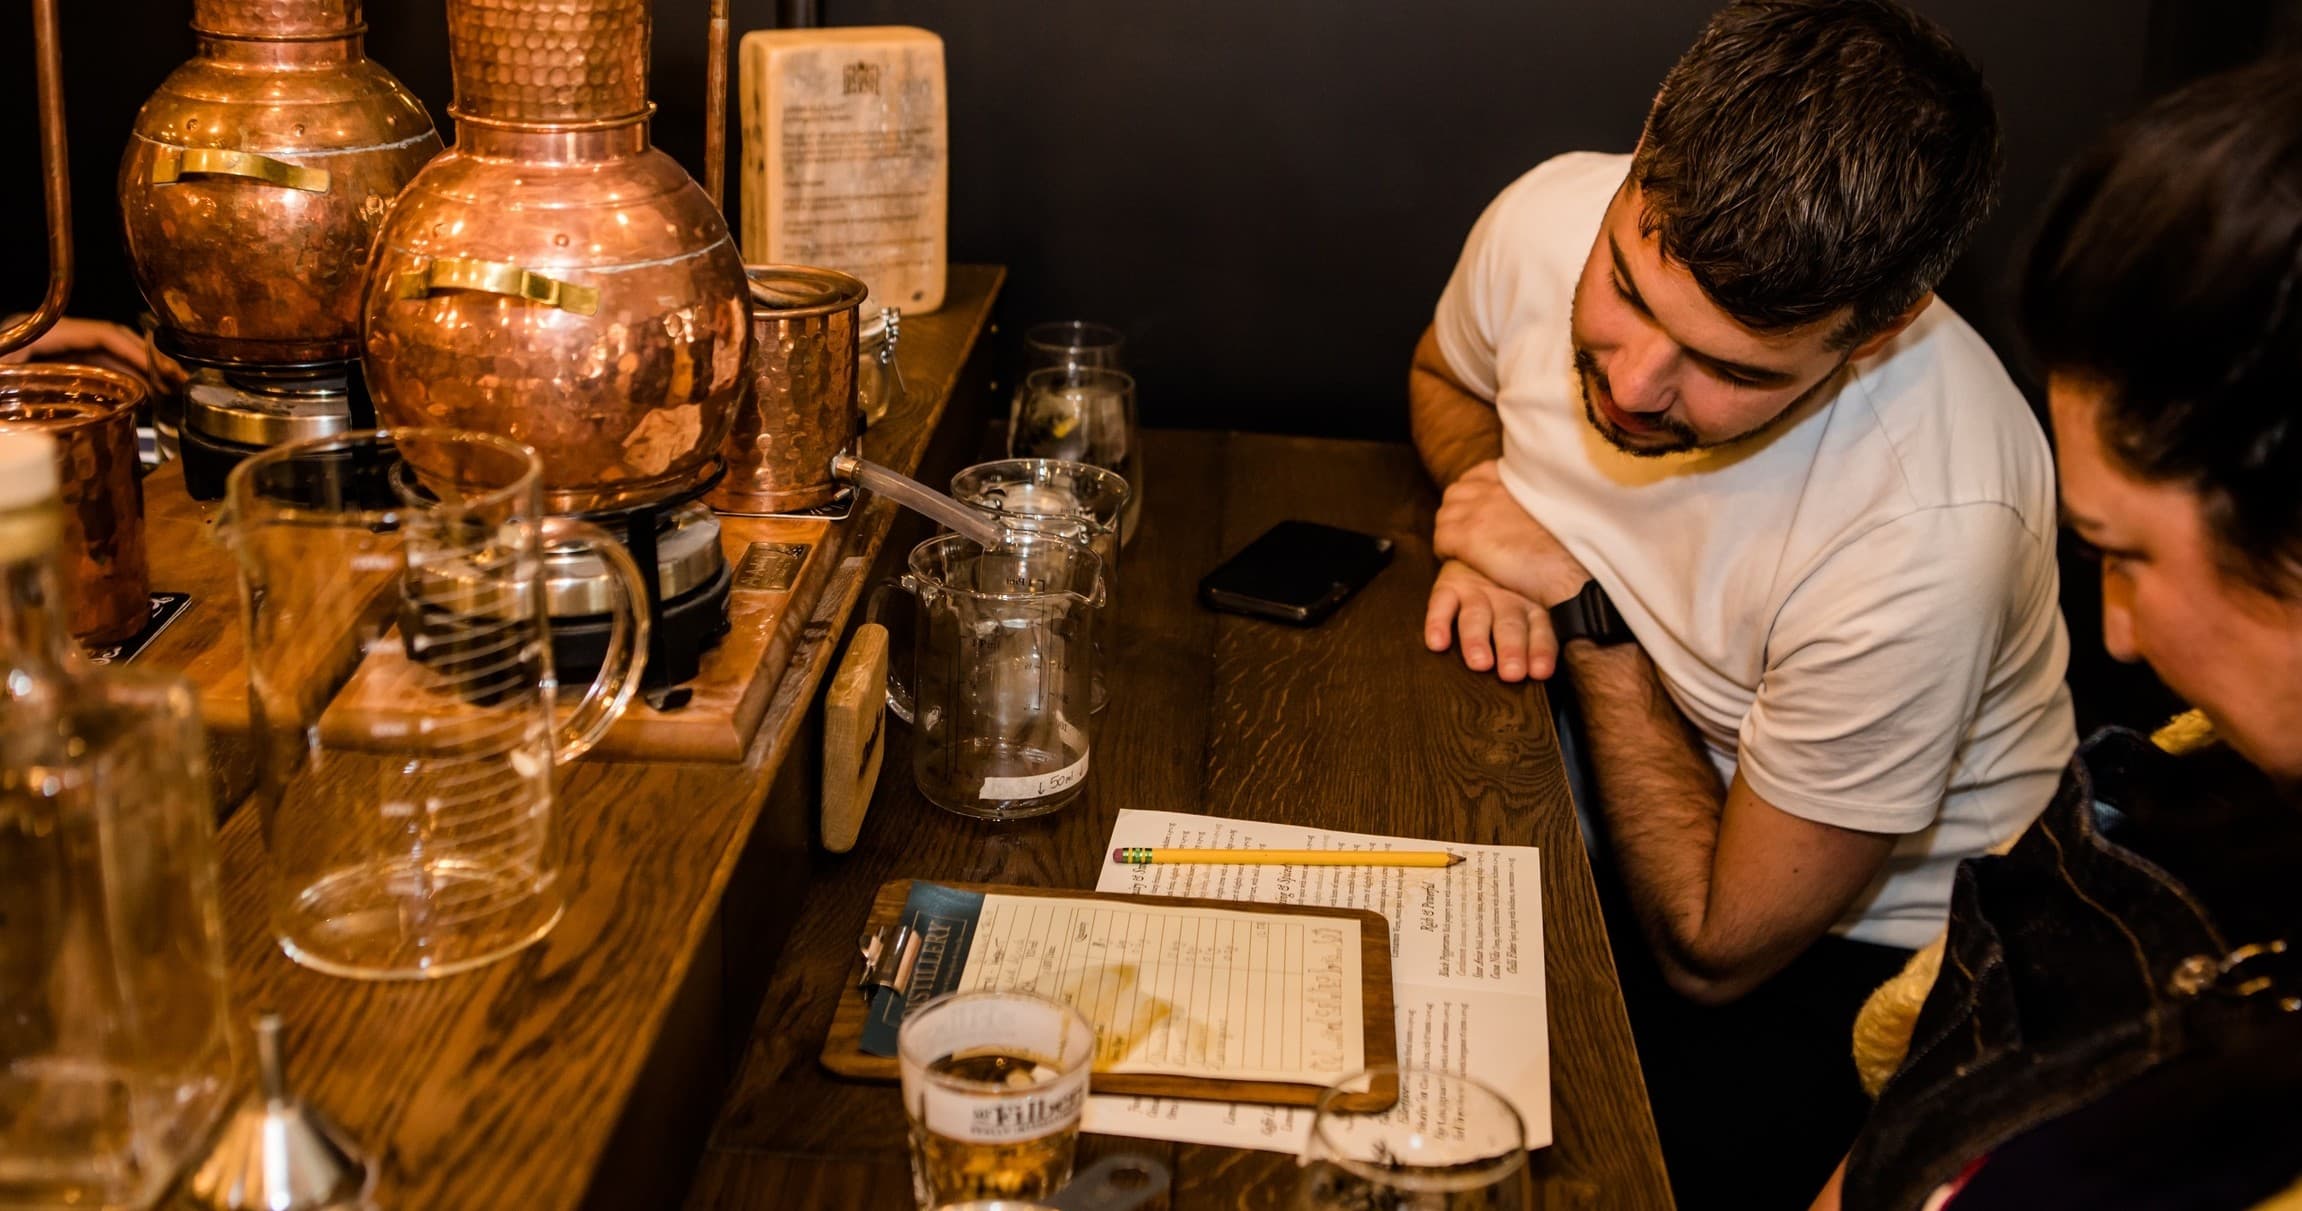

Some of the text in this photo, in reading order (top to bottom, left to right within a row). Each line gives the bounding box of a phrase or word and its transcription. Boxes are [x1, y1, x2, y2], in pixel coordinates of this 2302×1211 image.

[1420, 881, 1439, 933] Rich & Powerful
